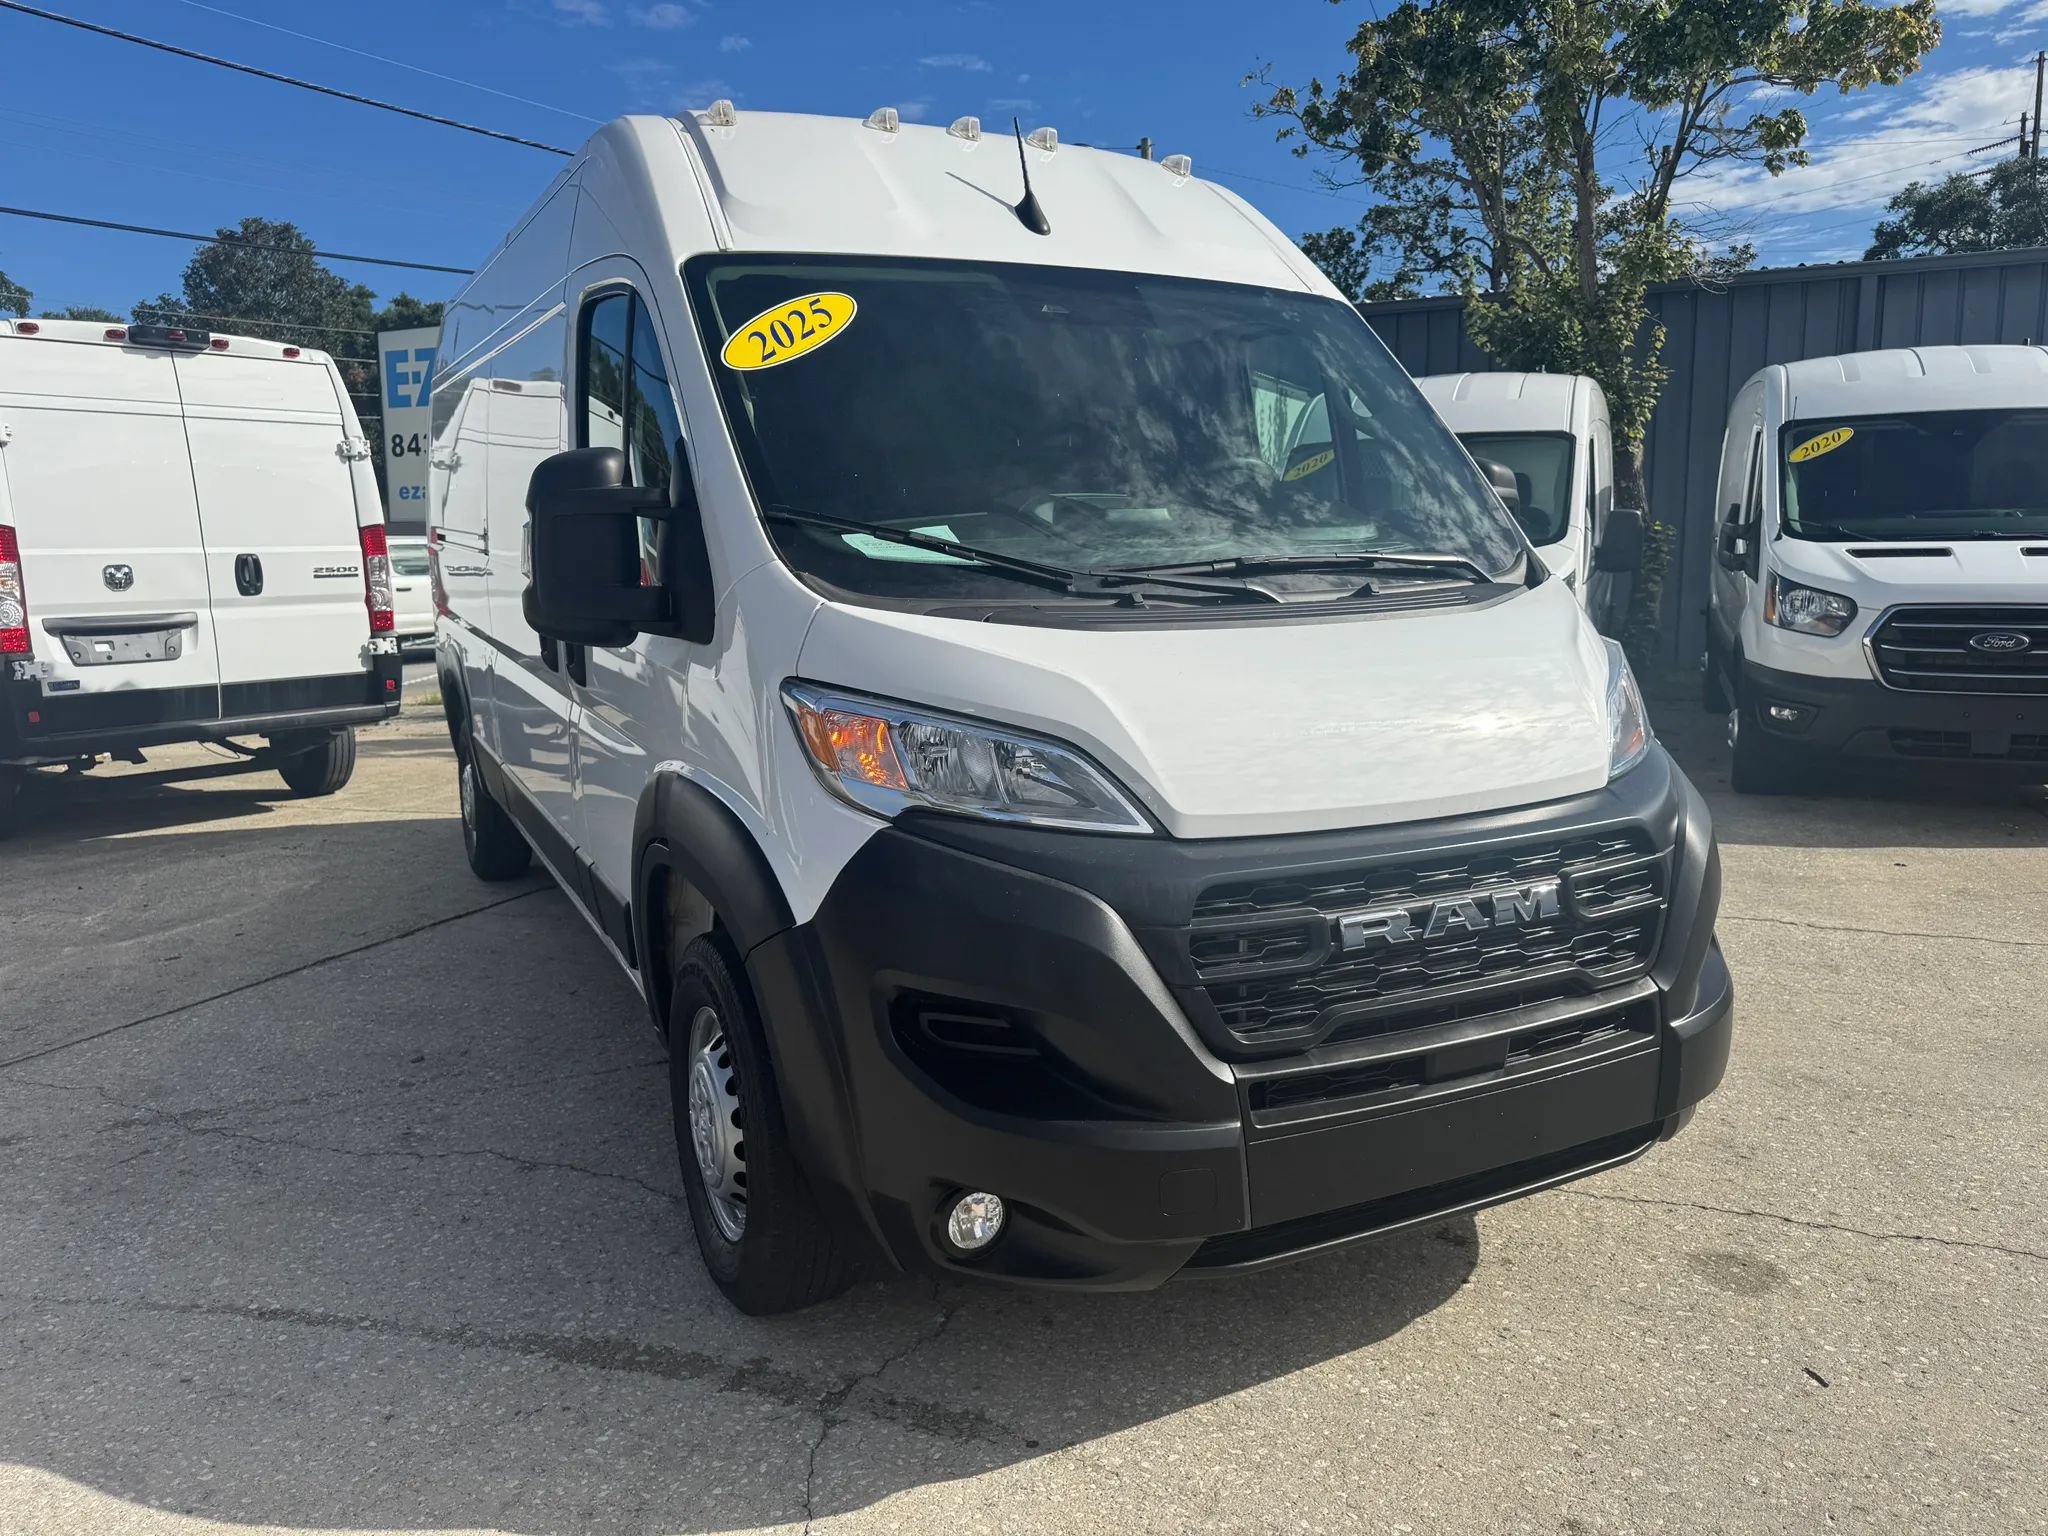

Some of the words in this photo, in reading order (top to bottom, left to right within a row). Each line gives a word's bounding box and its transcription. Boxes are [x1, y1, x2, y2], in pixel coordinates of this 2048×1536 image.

[748, 298, 832, 362] 2025
[391, 433, 427, 458] 84
[1800, 431, 1841, 459] 2020
[1295, 453, 1328, 478] 2020
[1984, 635, 2017, 648] Ford
[1338, 886, 1560, 951] RAM
